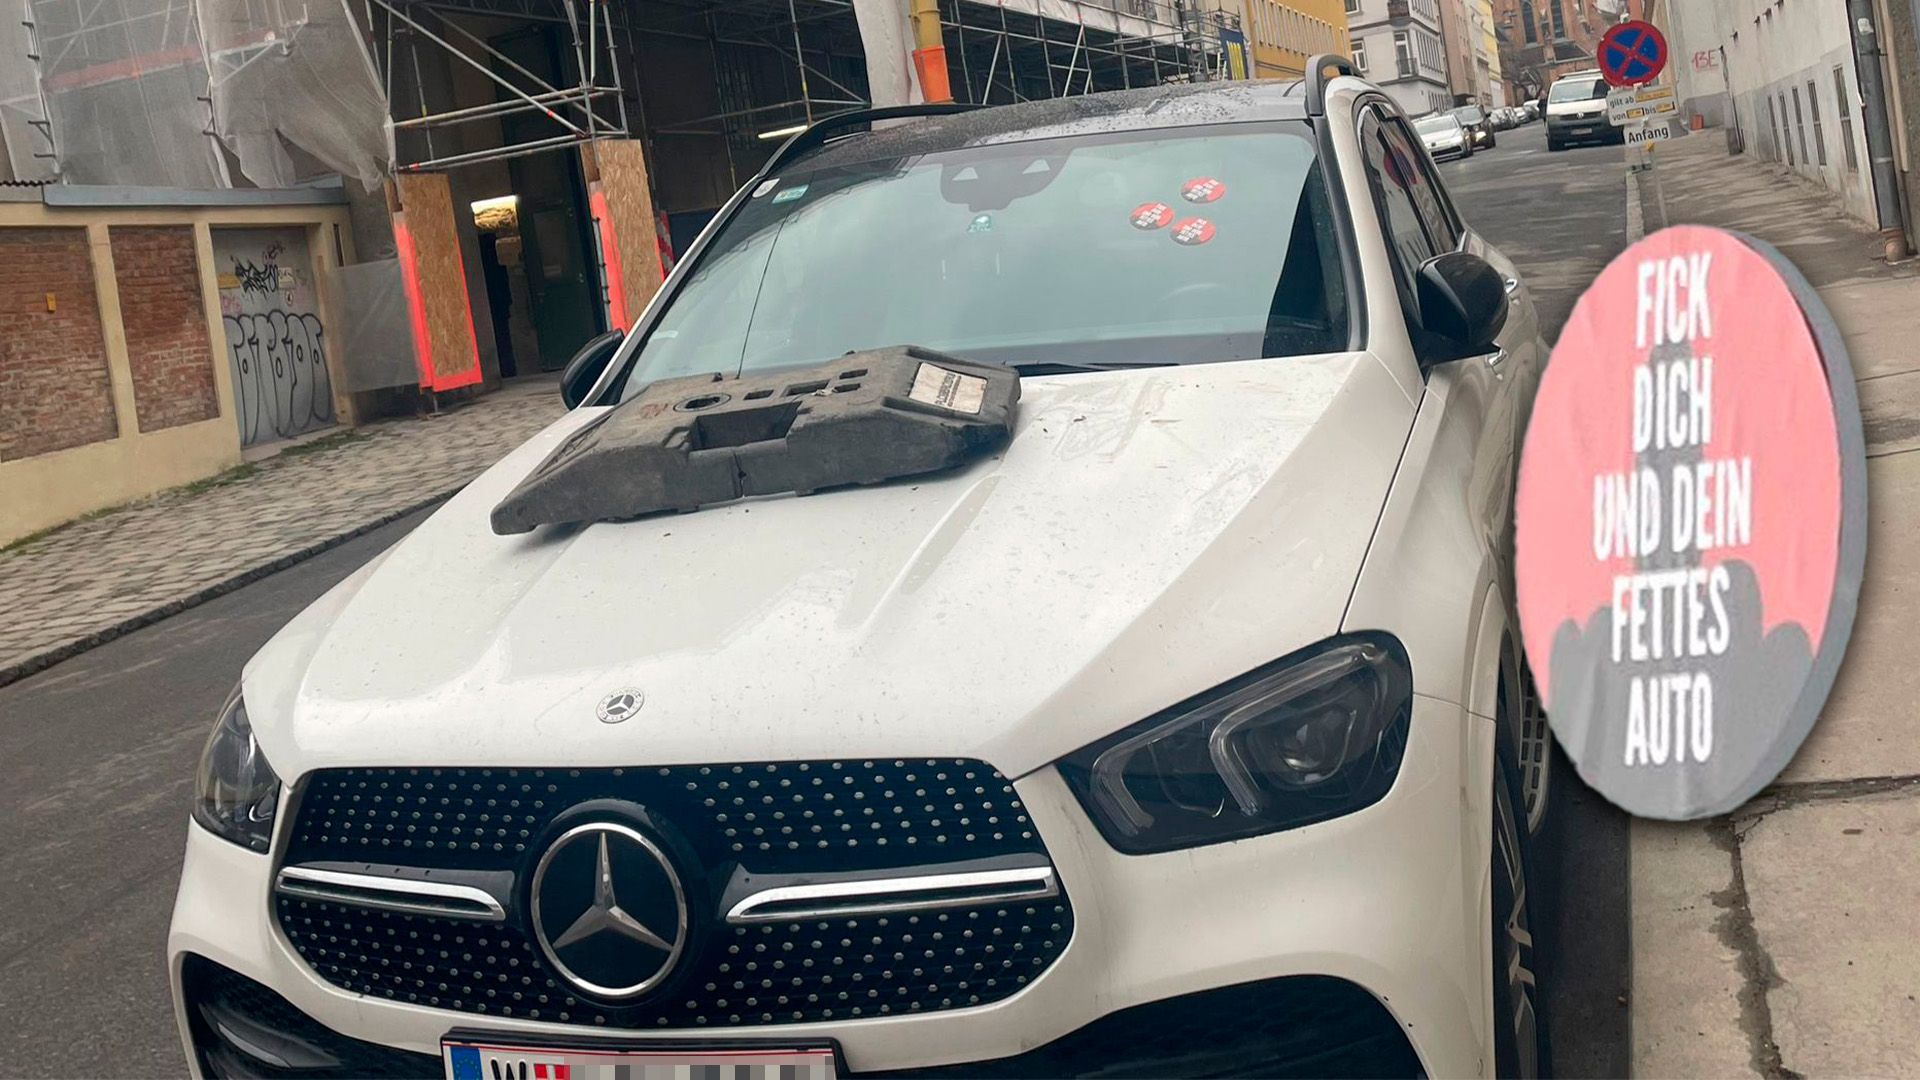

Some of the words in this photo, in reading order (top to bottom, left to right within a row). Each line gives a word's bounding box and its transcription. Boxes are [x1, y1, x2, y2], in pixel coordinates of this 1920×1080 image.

[1625, 95, 1635, 104] ab
[1612, 112, 1627, 121] von
[1645, 105, 1657, 114] bis
[1628, 127, 1669, 144] Anfang
